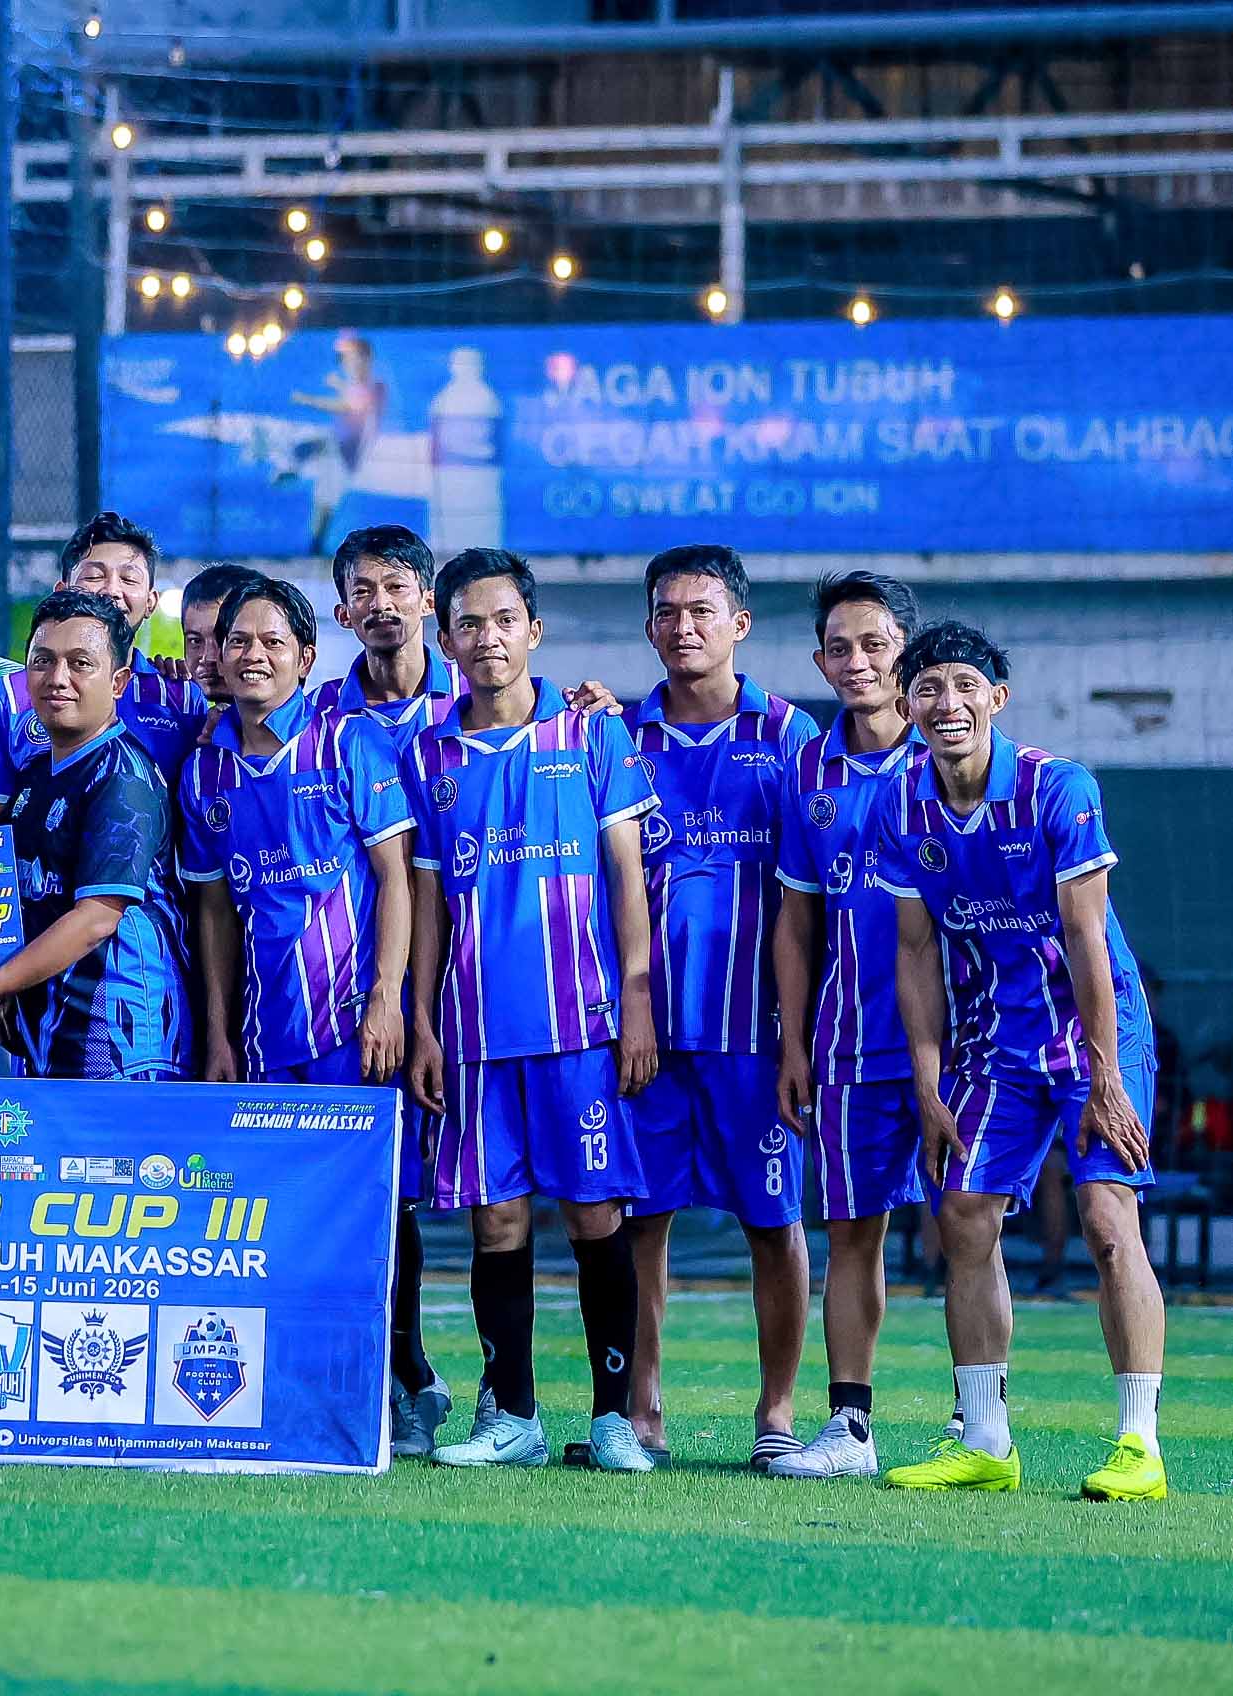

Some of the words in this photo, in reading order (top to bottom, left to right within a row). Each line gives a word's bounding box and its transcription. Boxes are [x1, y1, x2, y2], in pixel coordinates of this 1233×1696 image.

[687, 361, 768, 405] ION
[876, 415, 1006, 463] SAAT
[684, 806, 724, 827] Bank
[487, 821, 528, 844] Bank
[686, 827, 772, 846] Muamalat
[259, 844, 290, 866] Bank
[488, 839, 581, 866] Muamalat
[260, 855, 342, 885] Muamalat
[972, 897, 1015, 916] Bank
[231, 1113, 295, 1129] UNISMUH
[297, 1114, 374, 1130] MAKASSAR
[1, 1156, 26, 1164] IMPACT
[580, 1132, 608, 1171] 13
[1, 1164, 35, 1173] RANKINGS
[178, 1166, 203, 1190] UI
[202, 1169, 233, 1180] Green
[765, 1157, 783, 1196] 8
[202, 1179, 235, 1190] Metric
[29, 1192, 180, 1240] CUP
[204, 1197, 269, 1241] III
[56, 1244, 269, 1279] MAKASSAR
[44, 1277, 97, 1298] Juni
[104, 1279, 161, 1300] 2026
[182, 1345, 239, 1356] UMPAR
[18, 1434, 93, 1447] Universitas
[97, 1436, 203, 1451] Muhammadiyah
[206, 1438, 271, 1451] Makassar
